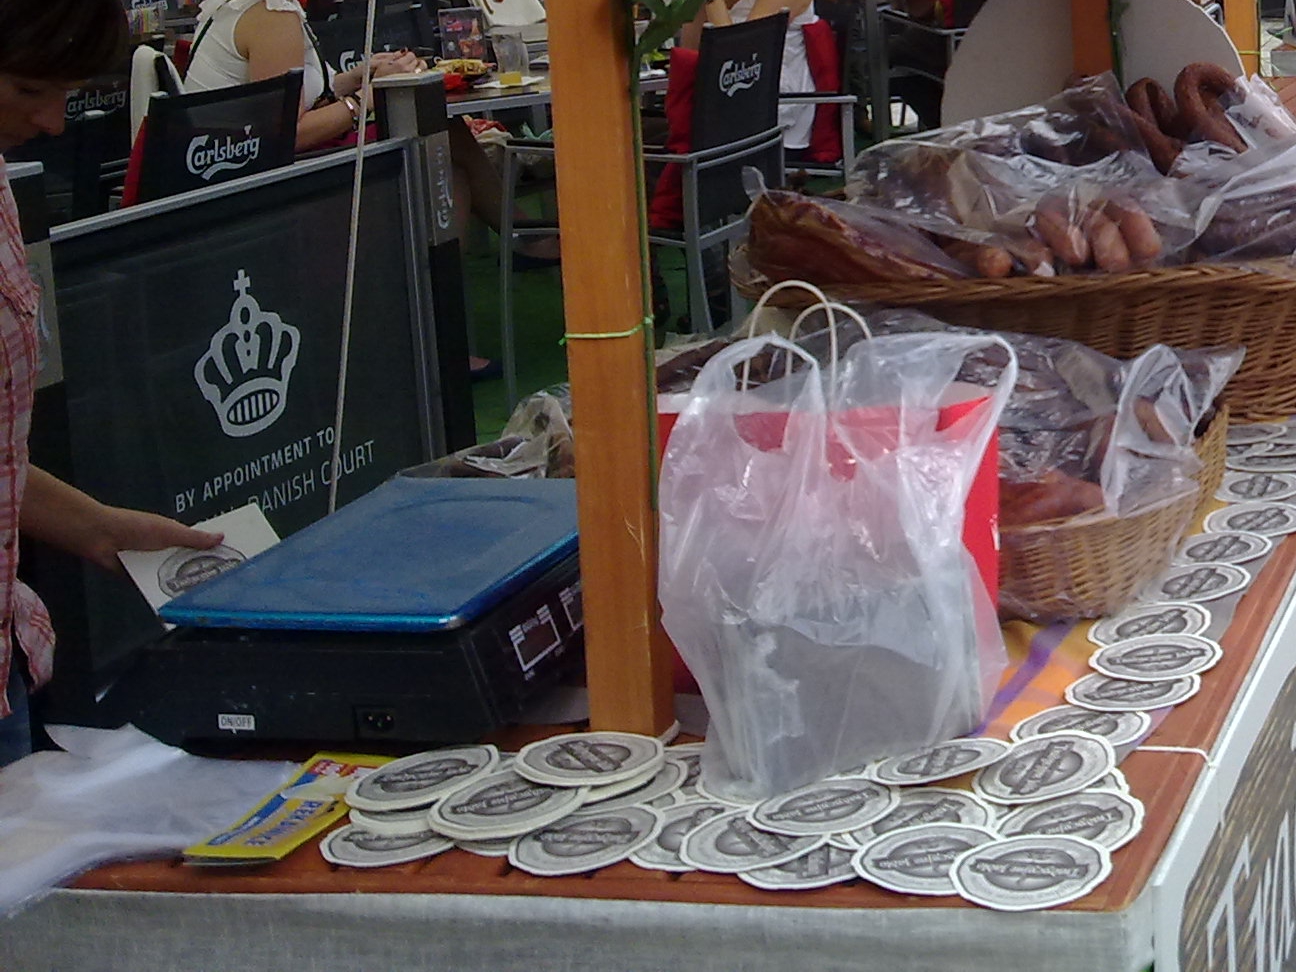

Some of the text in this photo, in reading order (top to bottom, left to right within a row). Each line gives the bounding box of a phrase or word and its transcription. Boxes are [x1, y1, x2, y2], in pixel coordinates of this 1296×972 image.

[719, 60, 762, 97] Carlsberg
[186, 132, 261, 180] Carlsberg
[175, 427, 335, 513] BY APPOINTMENT TO
[321, 440, 374, 485] COURT
